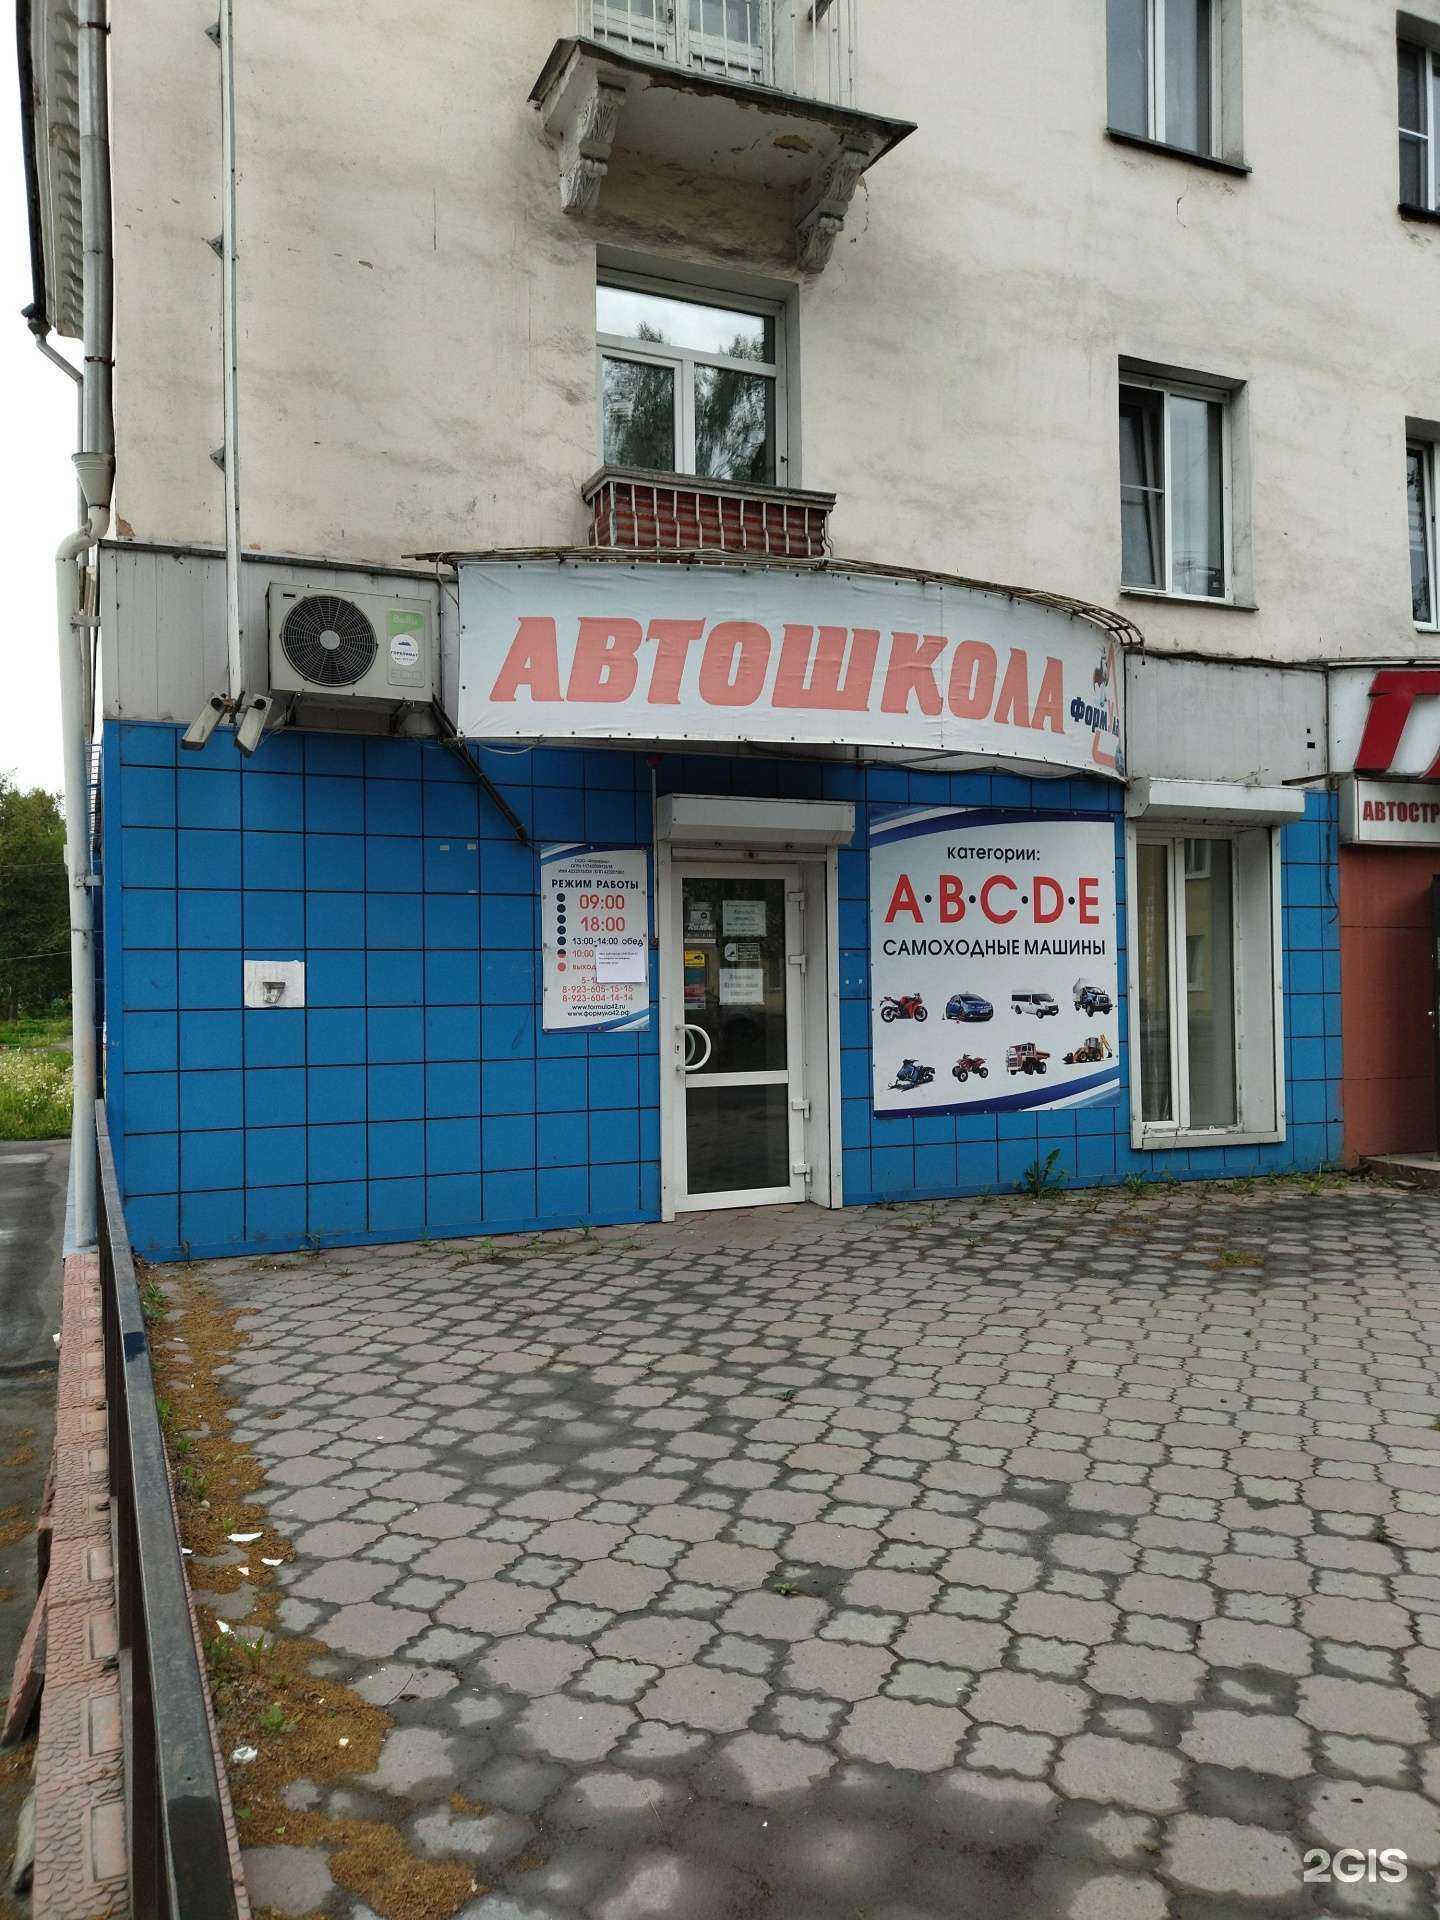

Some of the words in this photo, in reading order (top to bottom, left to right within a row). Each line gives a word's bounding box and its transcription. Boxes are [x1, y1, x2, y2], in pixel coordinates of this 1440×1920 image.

[489, 616, 1065, 734] АВТОШКОЛА
[947, 846, 1040, 862] категории:
[552, 879, 592, 889] РЕЖИМ
[596, 880, 639, 890] РАБОТЫ
[579, 894, 625, 911] 09:00
[580, 916, 626, 932] 18:00
[572, 937, 619, 945] 13:00-14:00
[621, 936, 644, 947] обед
[883, 939, 1020, 957] САМОХОДНЫЕ
[1024, 939, 1106, 956] МАШИНЫ
